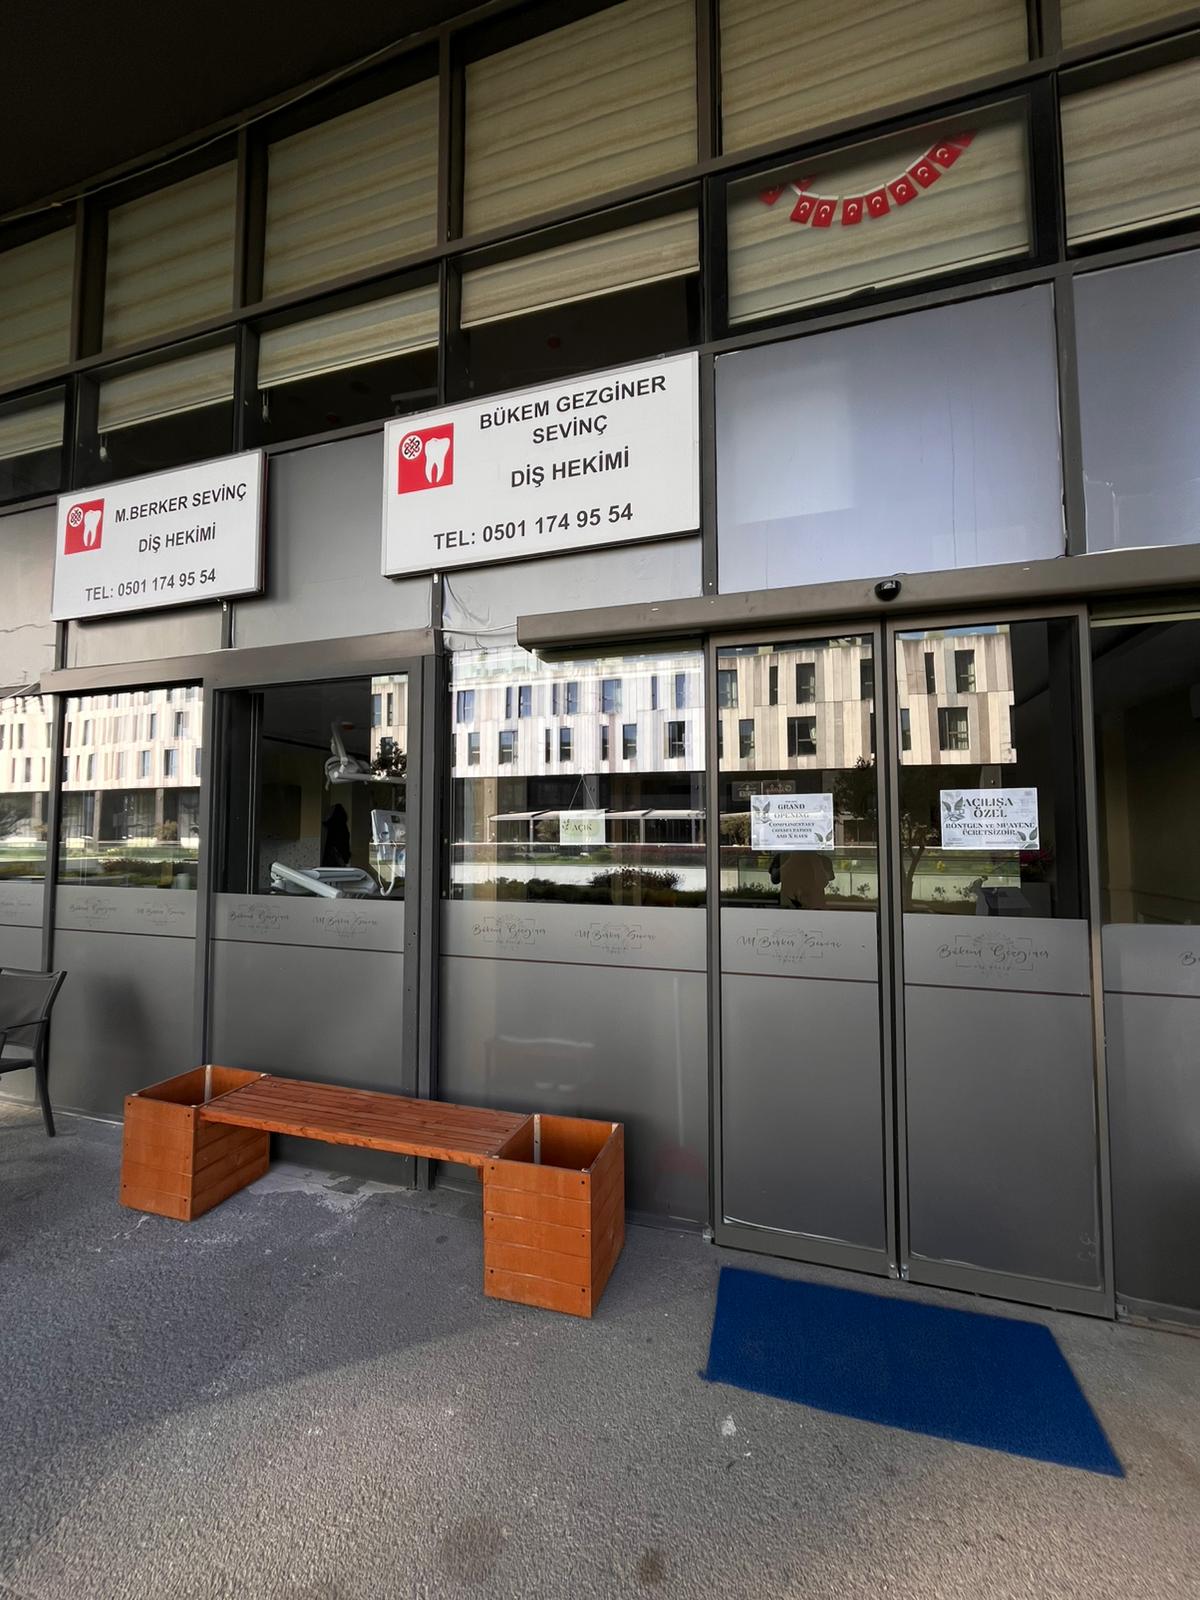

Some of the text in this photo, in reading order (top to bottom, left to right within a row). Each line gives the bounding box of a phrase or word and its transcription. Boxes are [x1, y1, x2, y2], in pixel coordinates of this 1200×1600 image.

[480, 375, 666, 430] BÜKEM GEZGİNER
[532, 415, 608, 444] SEVİNÇ
[511, 445, 629, 488] DİŞ HEKİMİ
[115, 483, 247, 523] M.BERKER SEVİNÇ
[139, 522, 216, 554] DİŞ HEKİMİ
[433, 502, 634, 550] TEL: 0501 174 95 54
[85, 568, 216, 602] TEL: 0501 174 95 54
[963, 797, 1014, 808] AÇILIŞA
[974, 807, 1008, 818] ÖZEL
